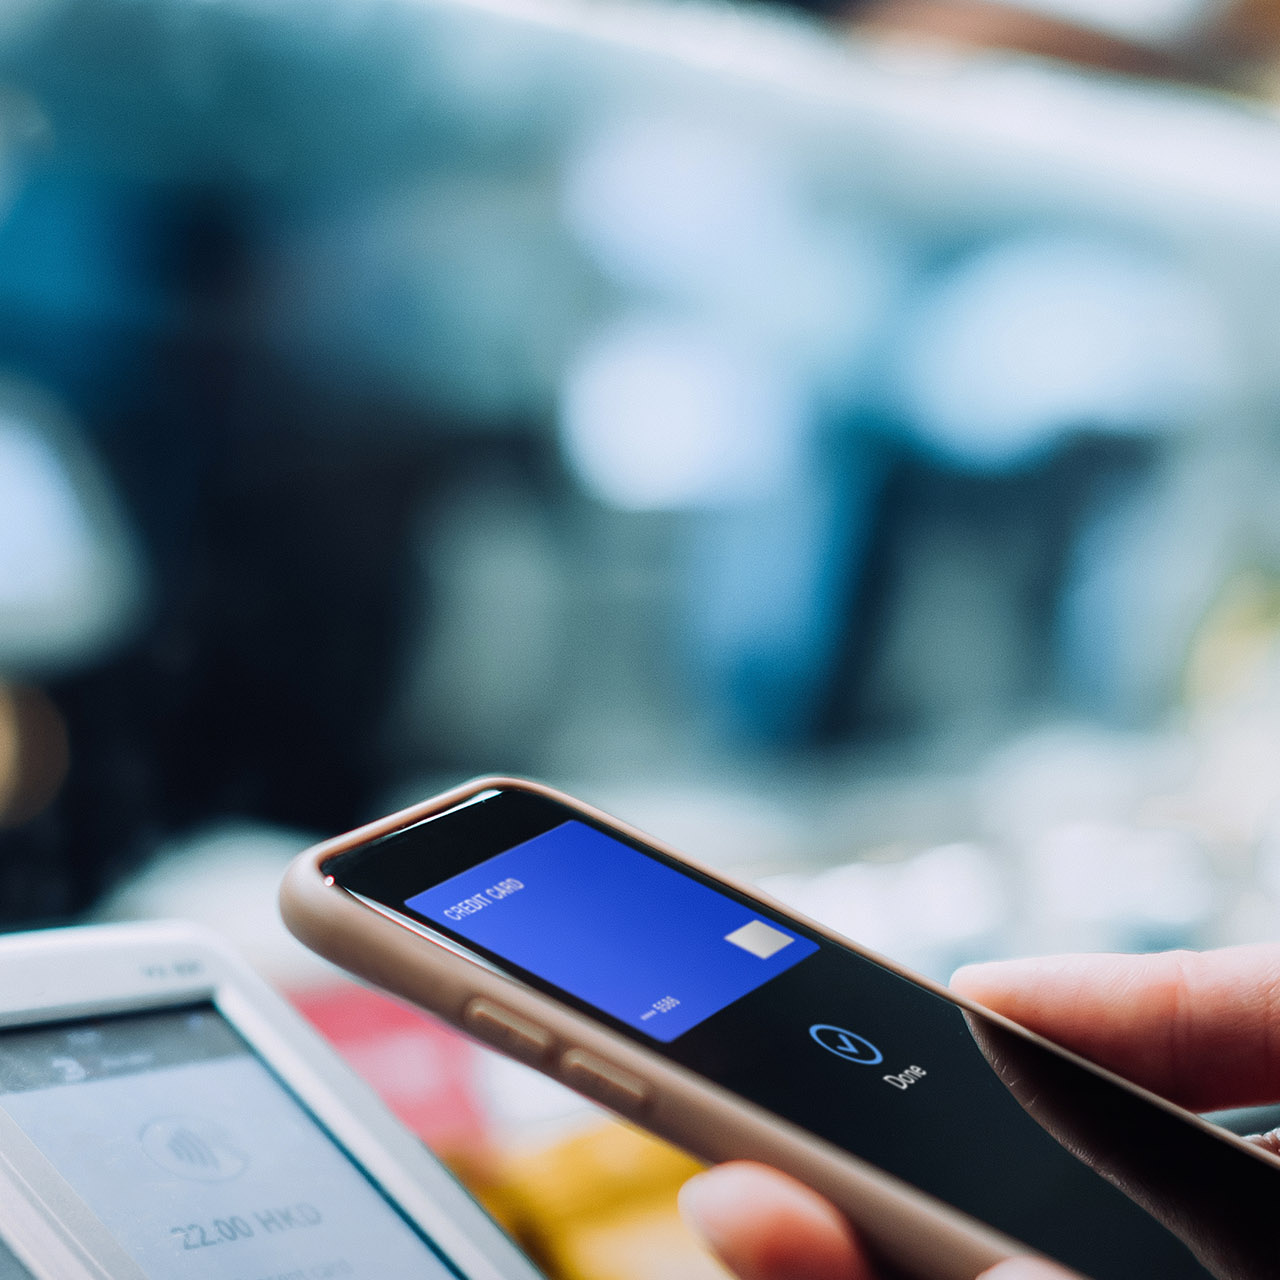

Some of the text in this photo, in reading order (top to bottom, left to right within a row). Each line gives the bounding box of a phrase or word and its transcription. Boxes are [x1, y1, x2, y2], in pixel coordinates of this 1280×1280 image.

[443, 877, 525, 921] CREDIT CARD
[882, 1064, 927, 1090] Done
[169, 1201, 324, 1251] 22.00 HKD
